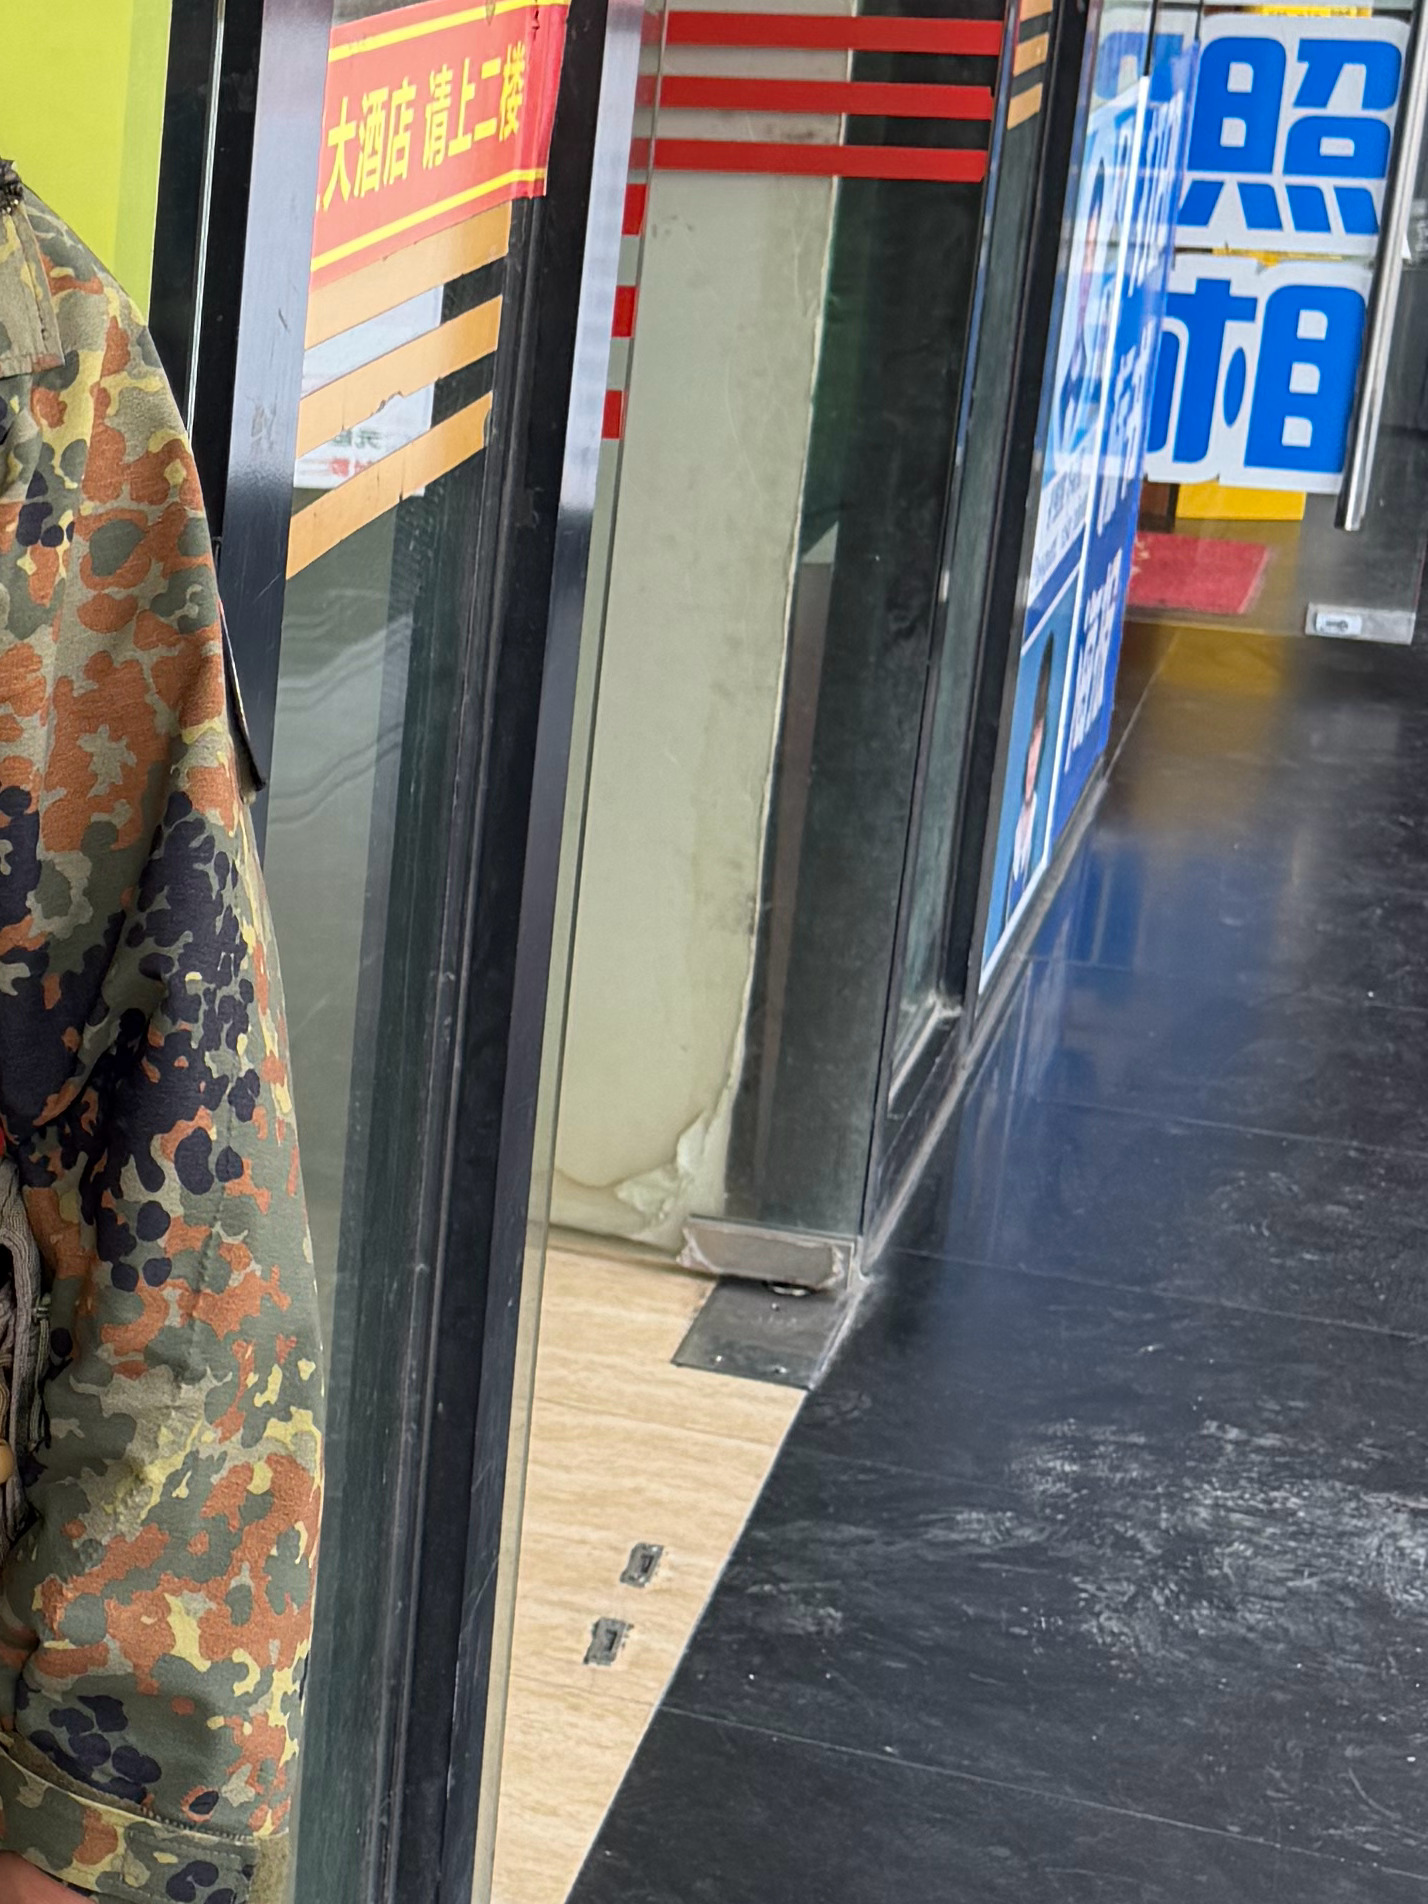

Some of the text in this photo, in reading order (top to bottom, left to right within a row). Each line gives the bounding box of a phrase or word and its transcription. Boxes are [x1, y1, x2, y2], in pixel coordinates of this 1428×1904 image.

[323, 41, 526, 212] 大酒店 请上二楼
